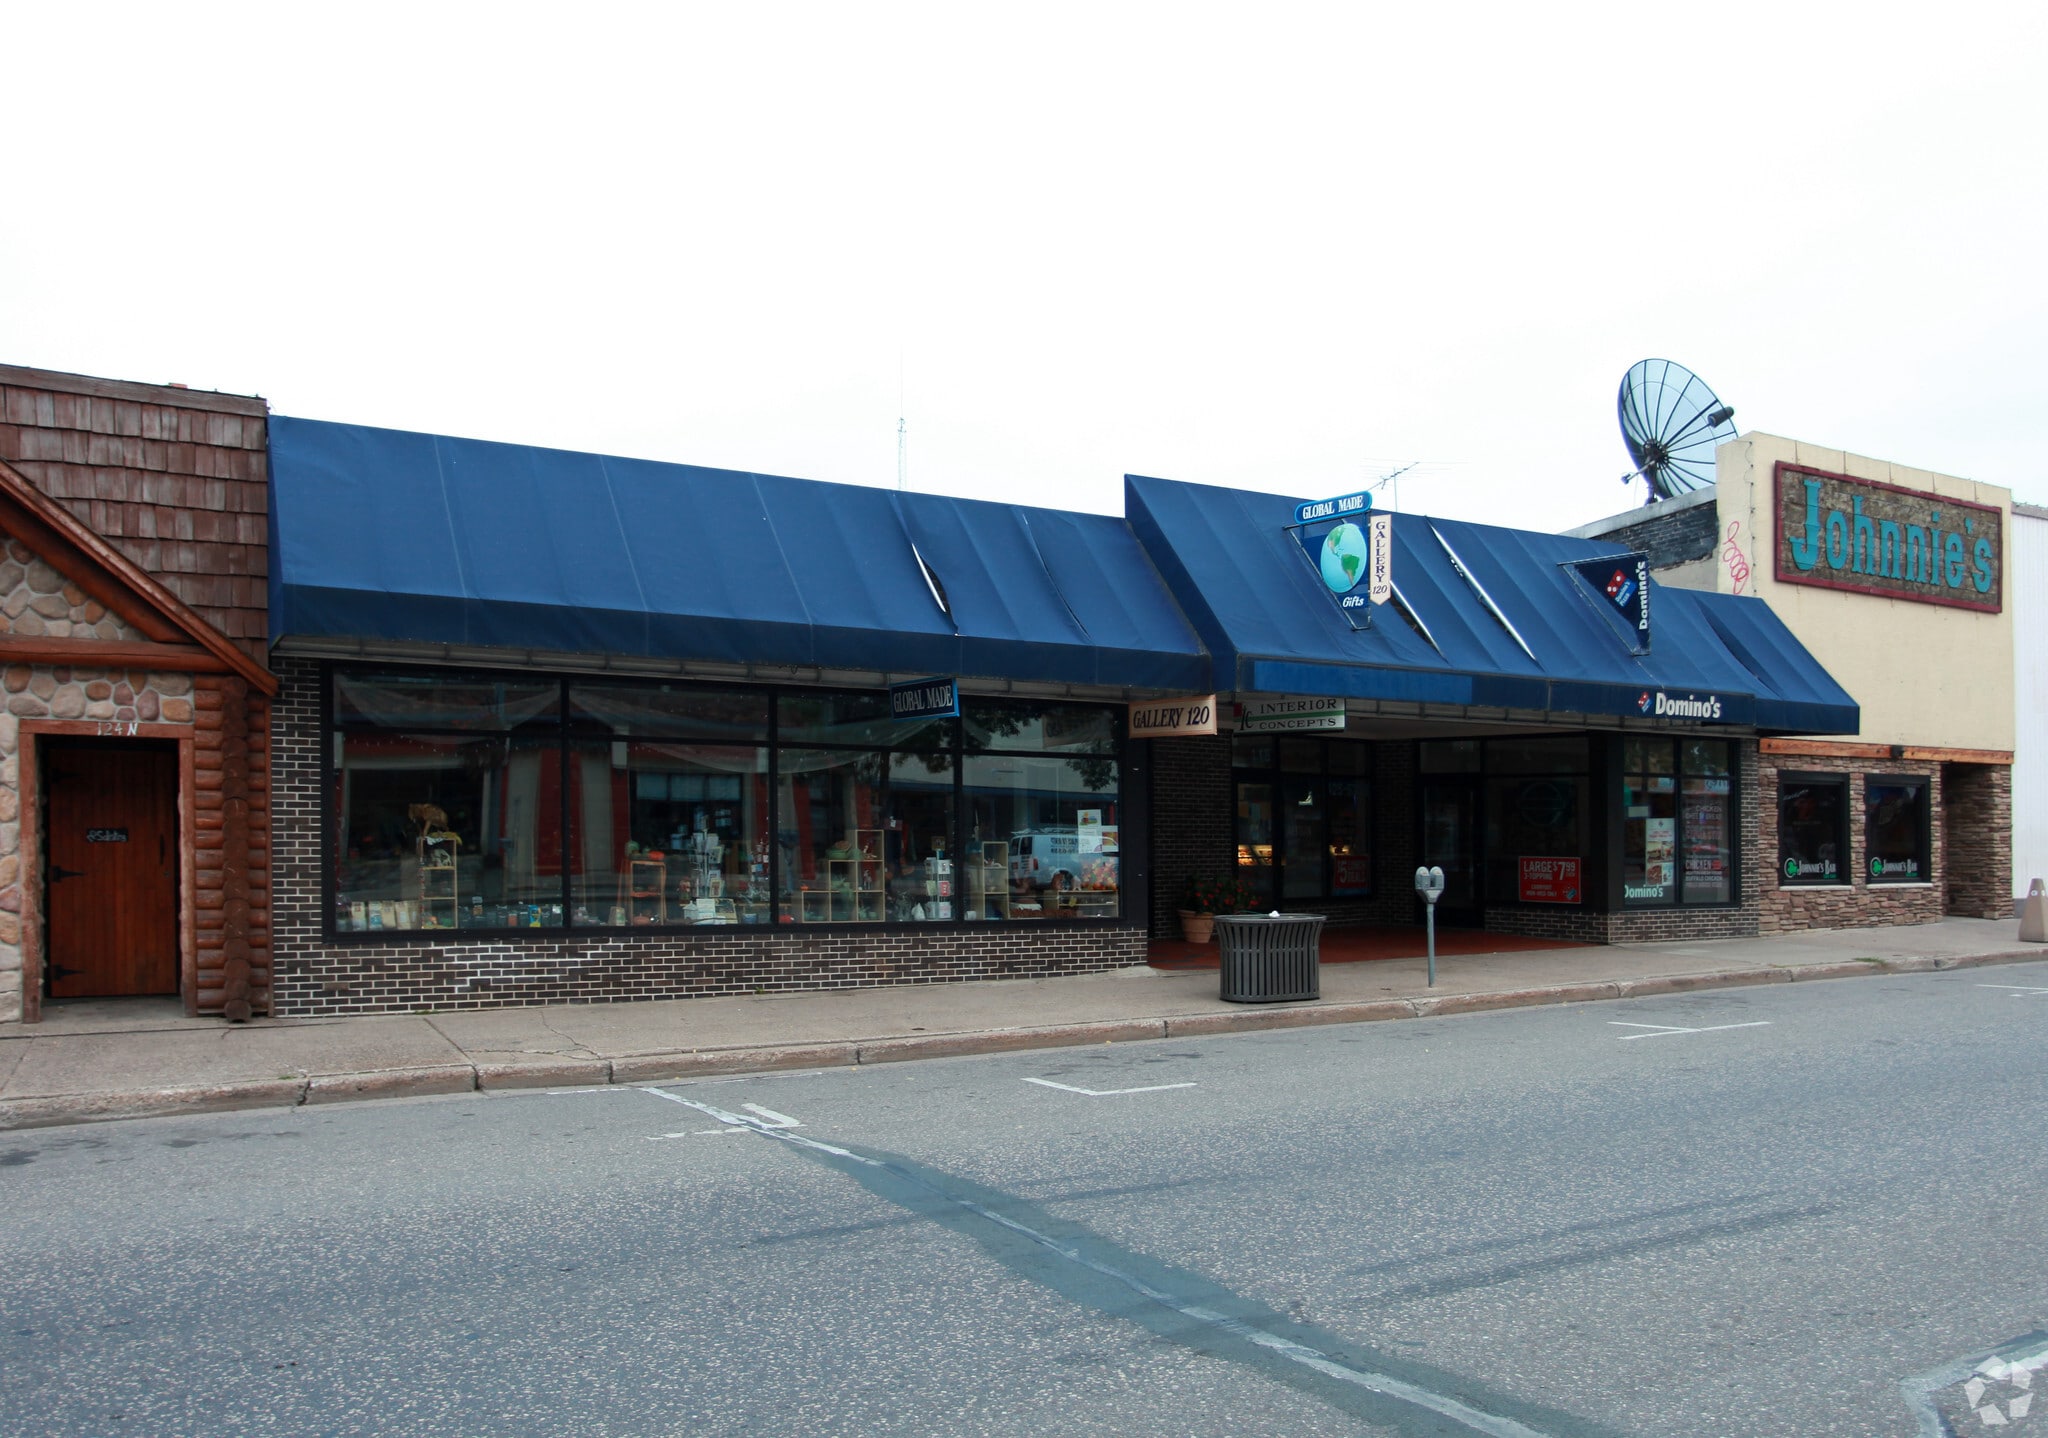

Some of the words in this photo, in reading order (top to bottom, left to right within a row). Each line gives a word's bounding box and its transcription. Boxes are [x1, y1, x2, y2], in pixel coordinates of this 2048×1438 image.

[1303, 502, 1335, 519] GLOBAL
[1338, 495, 1364, 512] MADE
[1789, 479, 1993, 592] Johnnie's
[1375, 521, 1385, 582] GALLERY
[1343, 596, 1364, 607] Gifts
[1373, 585, 1387, 594] 120
[1635, 561, 1648, 630] Domino's
[894, 690, 925, 713] GLOBAL
[926, 685, 953, 709] MADE
[1260, 698, 1337, 714] INTERIOR
[1655, 692, 1722, 719] Domino's
[97, 722, 124, 736] 124
[127, 720, 138, 737] N
[1133, 707, 1184, 729] GALLERY
[1187, 705, 1210, 726] 120
[1259, 718, 1337, 730] CONCEPTS
[1523, 861, 1553, 873] LARGE
